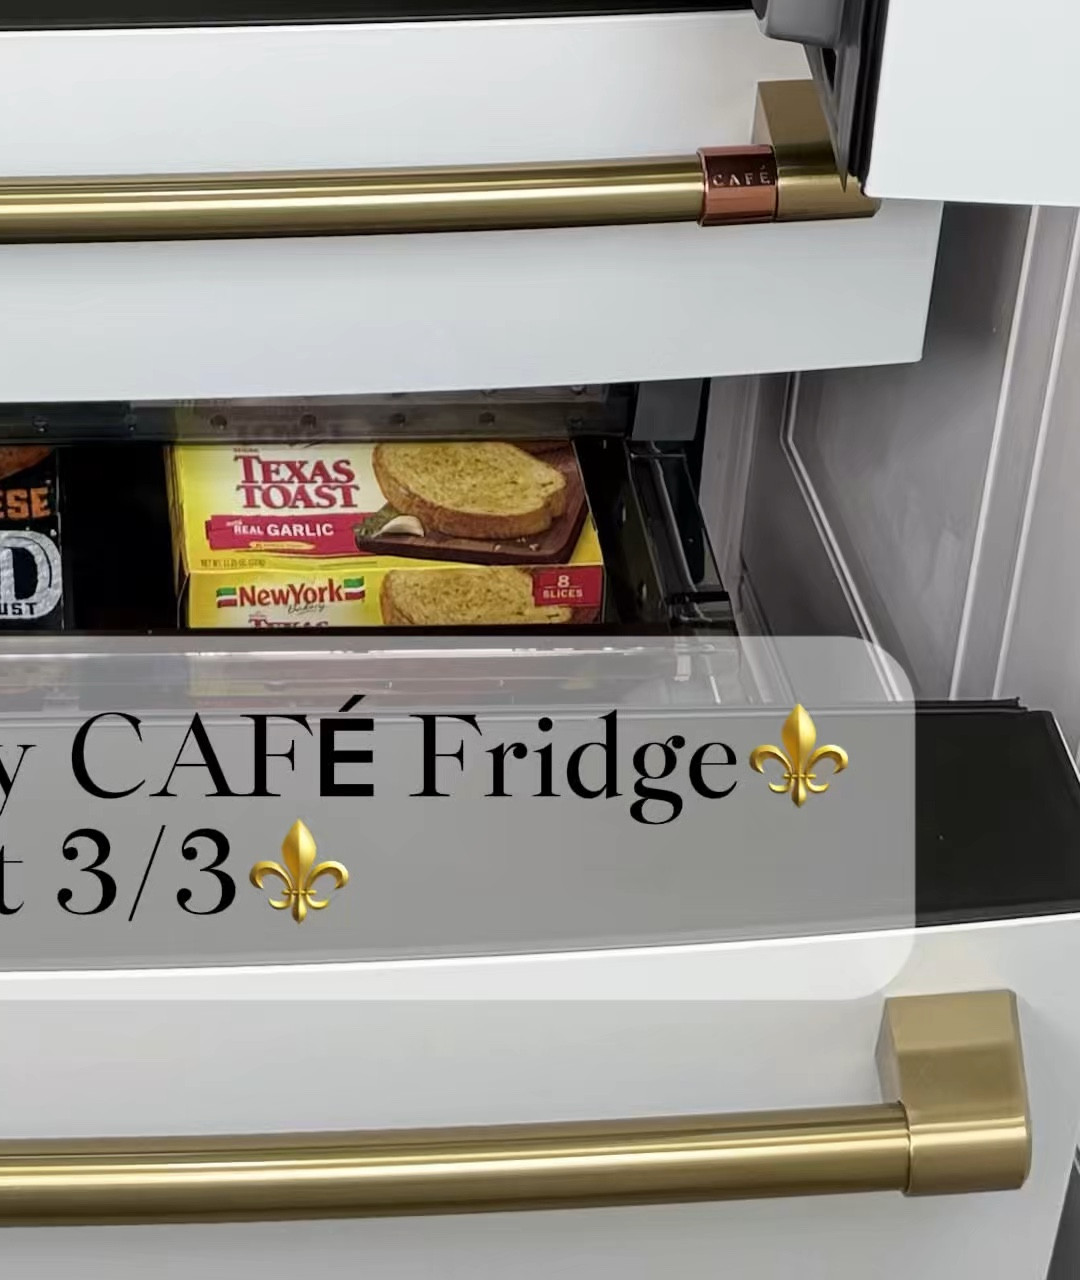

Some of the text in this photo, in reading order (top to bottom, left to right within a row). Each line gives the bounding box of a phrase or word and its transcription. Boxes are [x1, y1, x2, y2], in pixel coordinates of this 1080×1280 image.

[712, 163, 771, 187] CAFÉ
[233, 454, 356, 484] TEXAS
[236, 484, 360, 509] TOAST
[234, 523, 334, 537] REAL GARLIC
[557, 574, 570, 588] 8
[543, 588, 583, 599] SLICES
